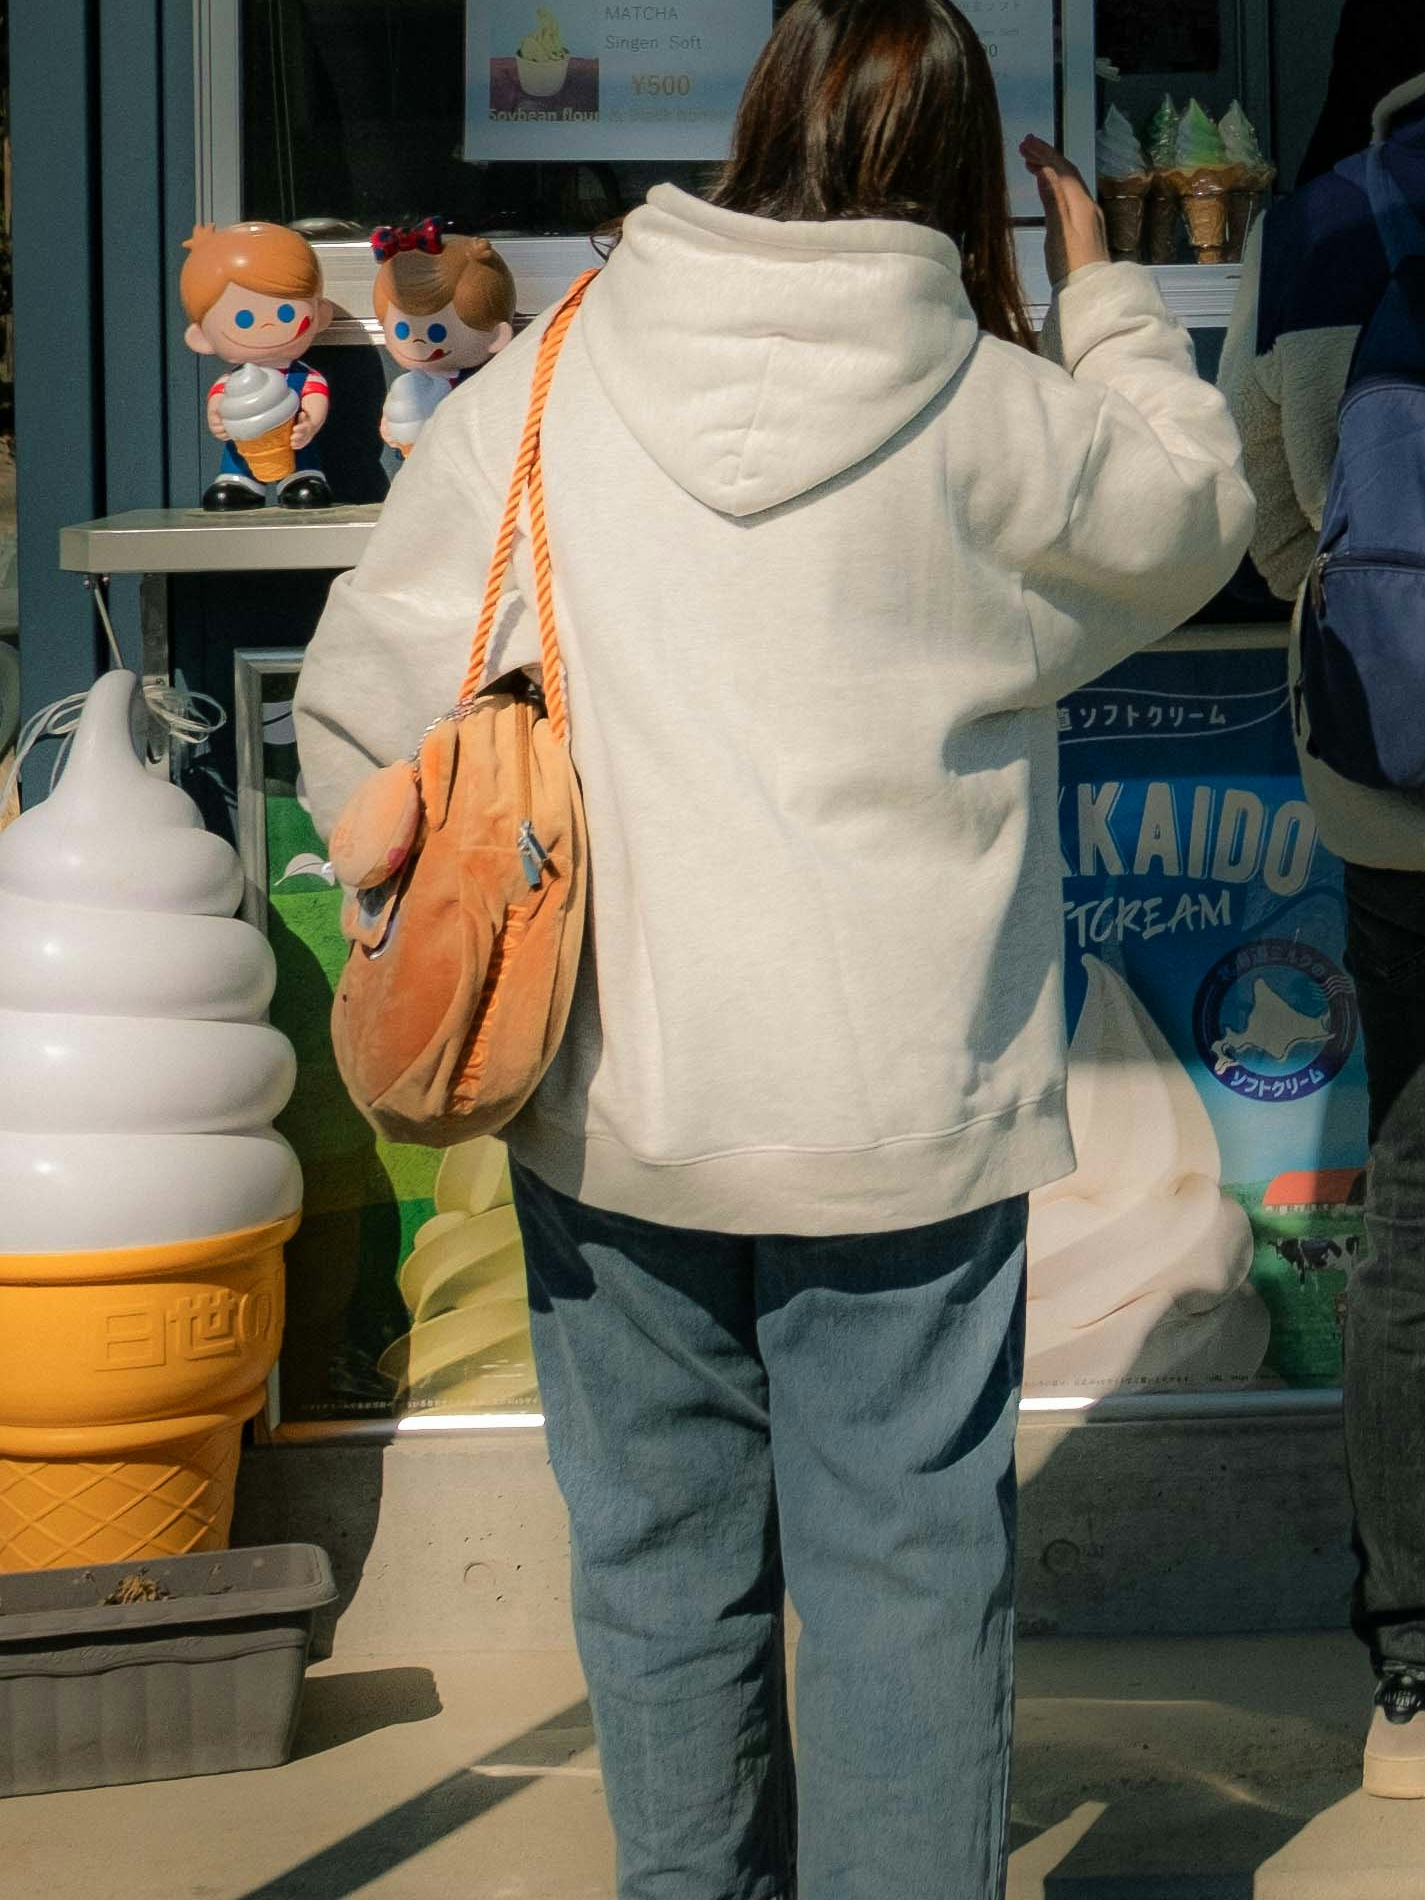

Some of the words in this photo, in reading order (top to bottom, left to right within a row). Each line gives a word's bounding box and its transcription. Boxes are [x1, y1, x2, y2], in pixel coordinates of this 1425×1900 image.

[605, 5, 679, 21] MATCHA
[605, 34, 660, 53] Singen
[668, 34, 704, 51] Soft
[633, 74, 691, 97] ¥500
[1052, 780, 1320, 898] KAIDO
[1230, 1066, 1325, 1098] ソフトクリーム
